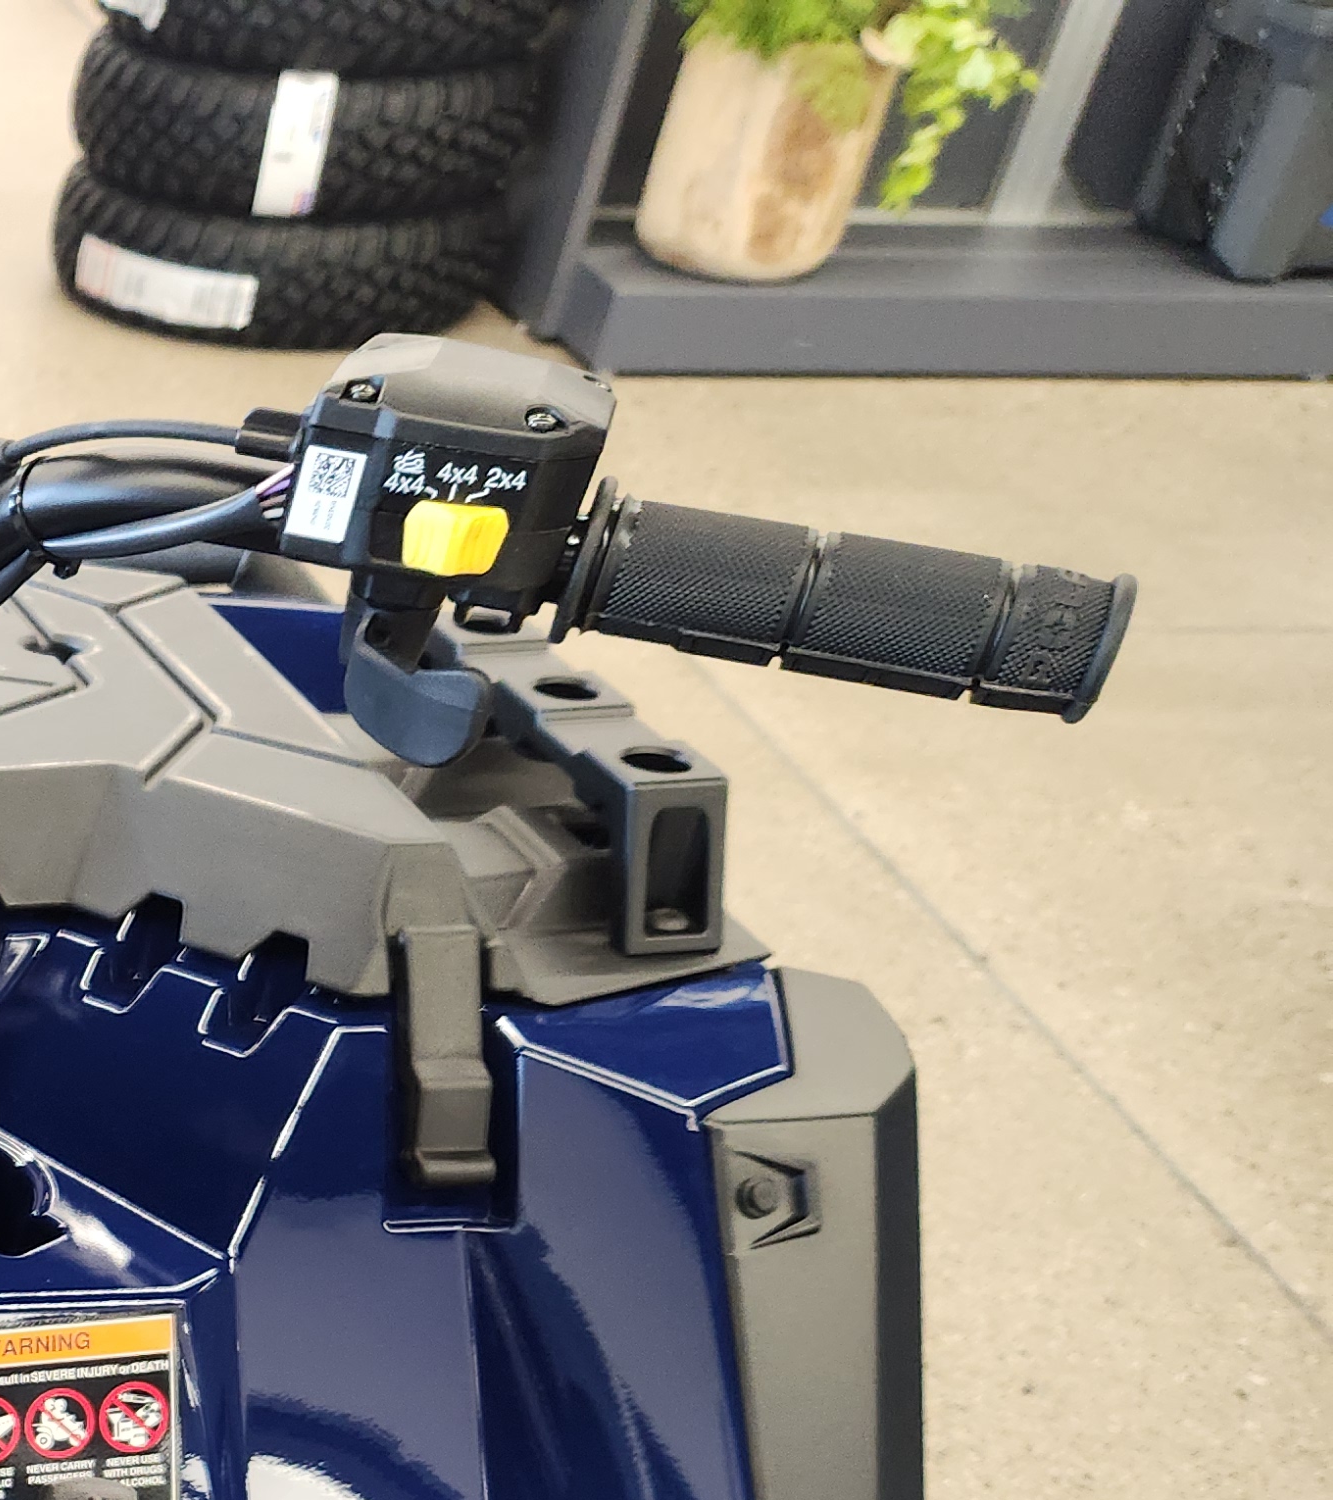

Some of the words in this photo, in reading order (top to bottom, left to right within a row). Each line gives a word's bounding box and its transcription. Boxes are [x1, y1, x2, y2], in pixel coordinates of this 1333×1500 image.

[31, 1367, 76, 1382] SEVERE
[77, 1364, 116, 1378] INJURY
[132, 1359, 168, 1373] DEATH
[26, 1462, 59, 1474] NEVER
[60, 1459, 94, 1471] CARRY
[106, 1456, 139, 1467] NEVER
[140, 1454, 160, 1464] USE
[102, 1467, 128, 1478] WITH
[130, 1464, 164, 1476] DRUGS
